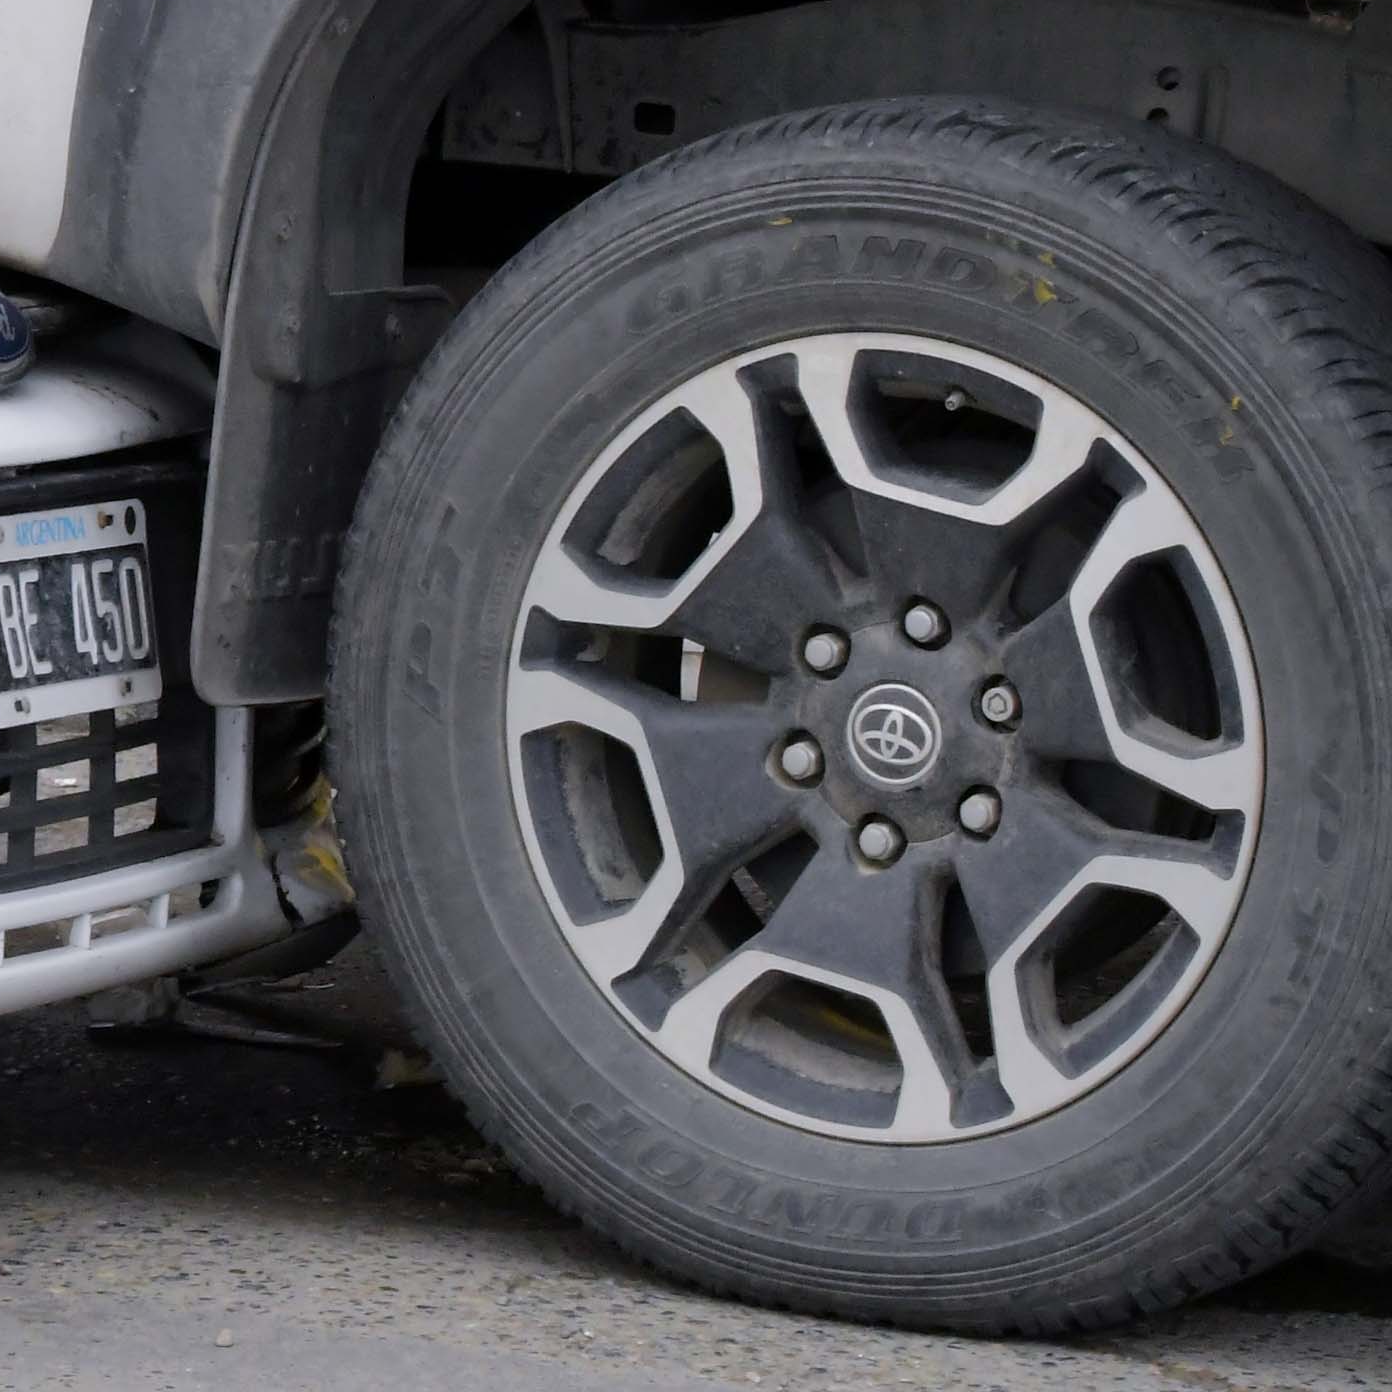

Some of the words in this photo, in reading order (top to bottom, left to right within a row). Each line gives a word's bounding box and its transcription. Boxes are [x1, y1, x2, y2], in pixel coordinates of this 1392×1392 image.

[624, 233, 1255, 483] GRANDTREK
[15, 516, 87, 546] ARGENTINA
[70, 556, 150, 665] 450
[568, 1100, 973, 1242] DUNLOP
